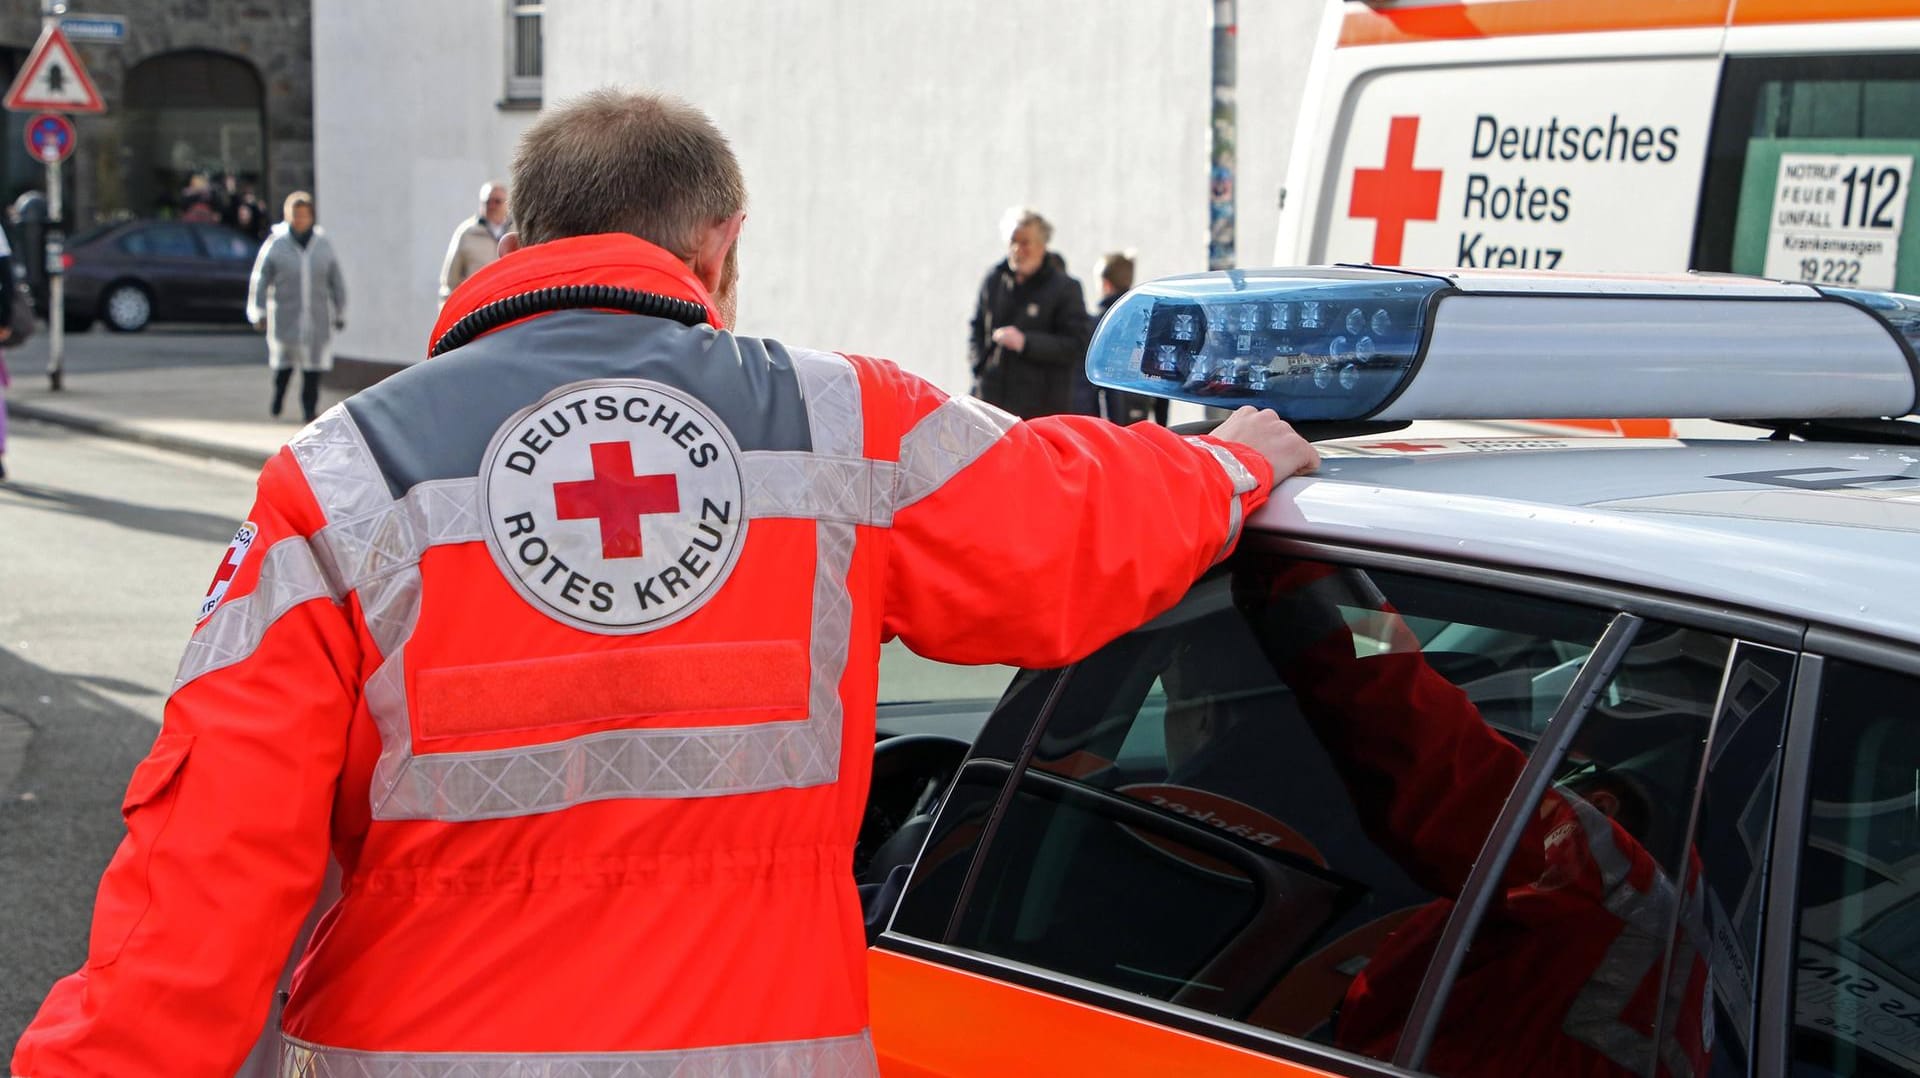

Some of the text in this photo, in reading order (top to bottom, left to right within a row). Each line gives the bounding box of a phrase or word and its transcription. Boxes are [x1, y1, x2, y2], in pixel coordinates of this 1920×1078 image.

[1472, 115, 1679, 163] Deutsches
[1785, 163, 1839, 179] NOTRUF
[1464, 174, 1571, 222] Rotes
[1781, 186, 1836, 204] FEUER
[1842, 165, 1901, 228] 112
[1779, 210, 1832, 229] UNFALL
[1457, 232, 1563, 269] Kreuz
[1783, 233, 1883, 256] Krankenwagen
[505, 395, 719, 476] DEUTSCHES
[504, 498, 731, 612] ROTES KREUZ
